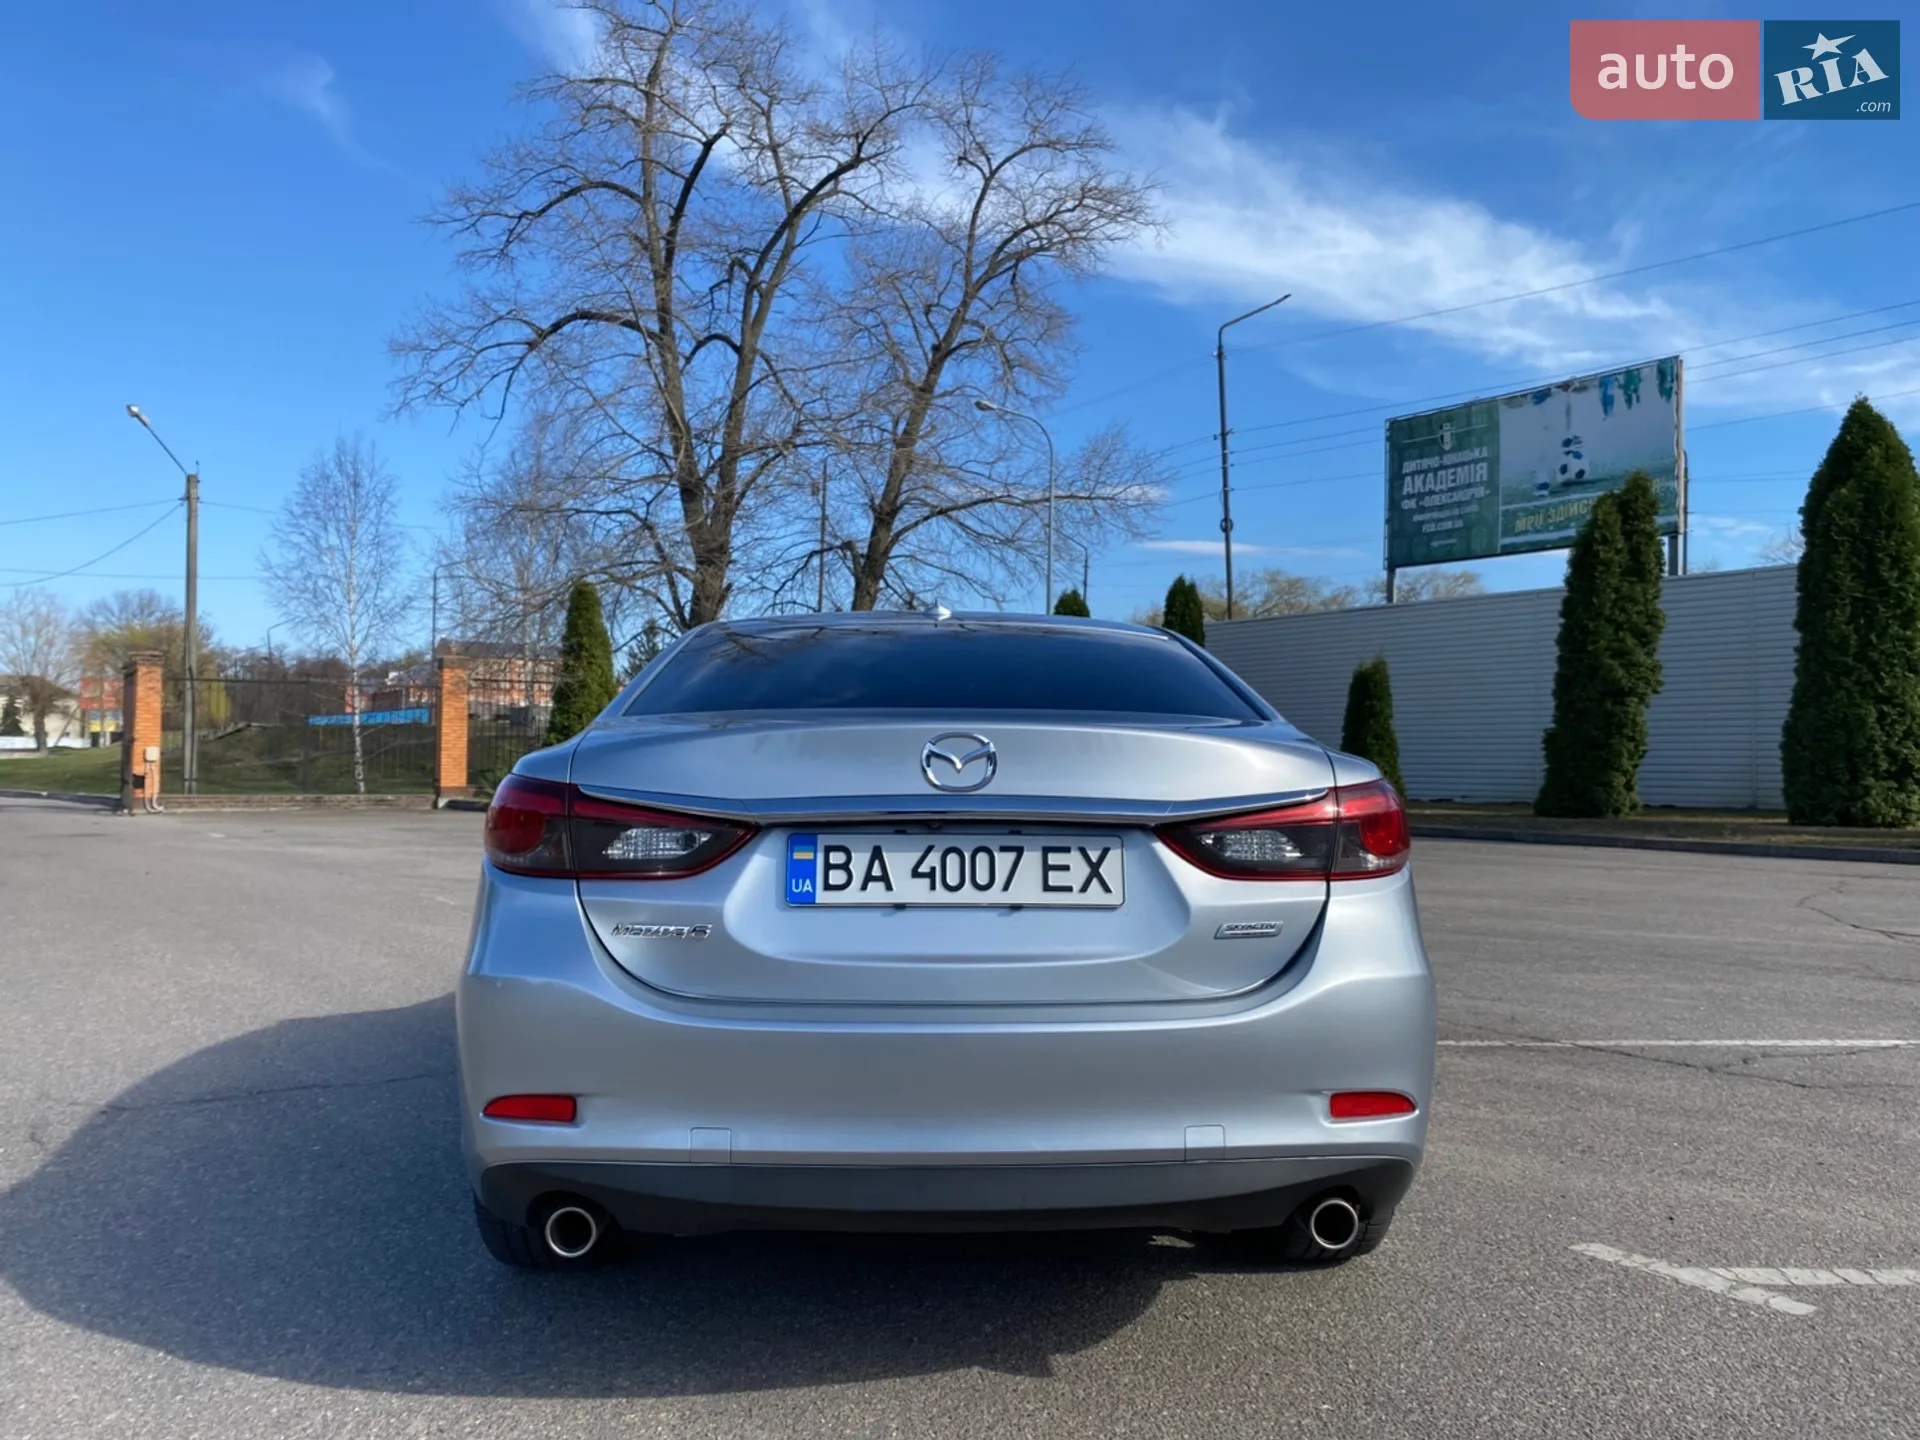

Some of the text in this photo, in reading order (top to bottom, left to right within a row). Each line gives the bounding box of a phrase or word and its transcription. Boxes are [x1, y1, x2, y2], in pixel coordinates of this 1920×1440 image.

[1402, 462, 1488, 495] АКАДЕМІЯ
[823, 844, 1113, 893] BA 4007 EX
[792, 878, 813, 893] UA
